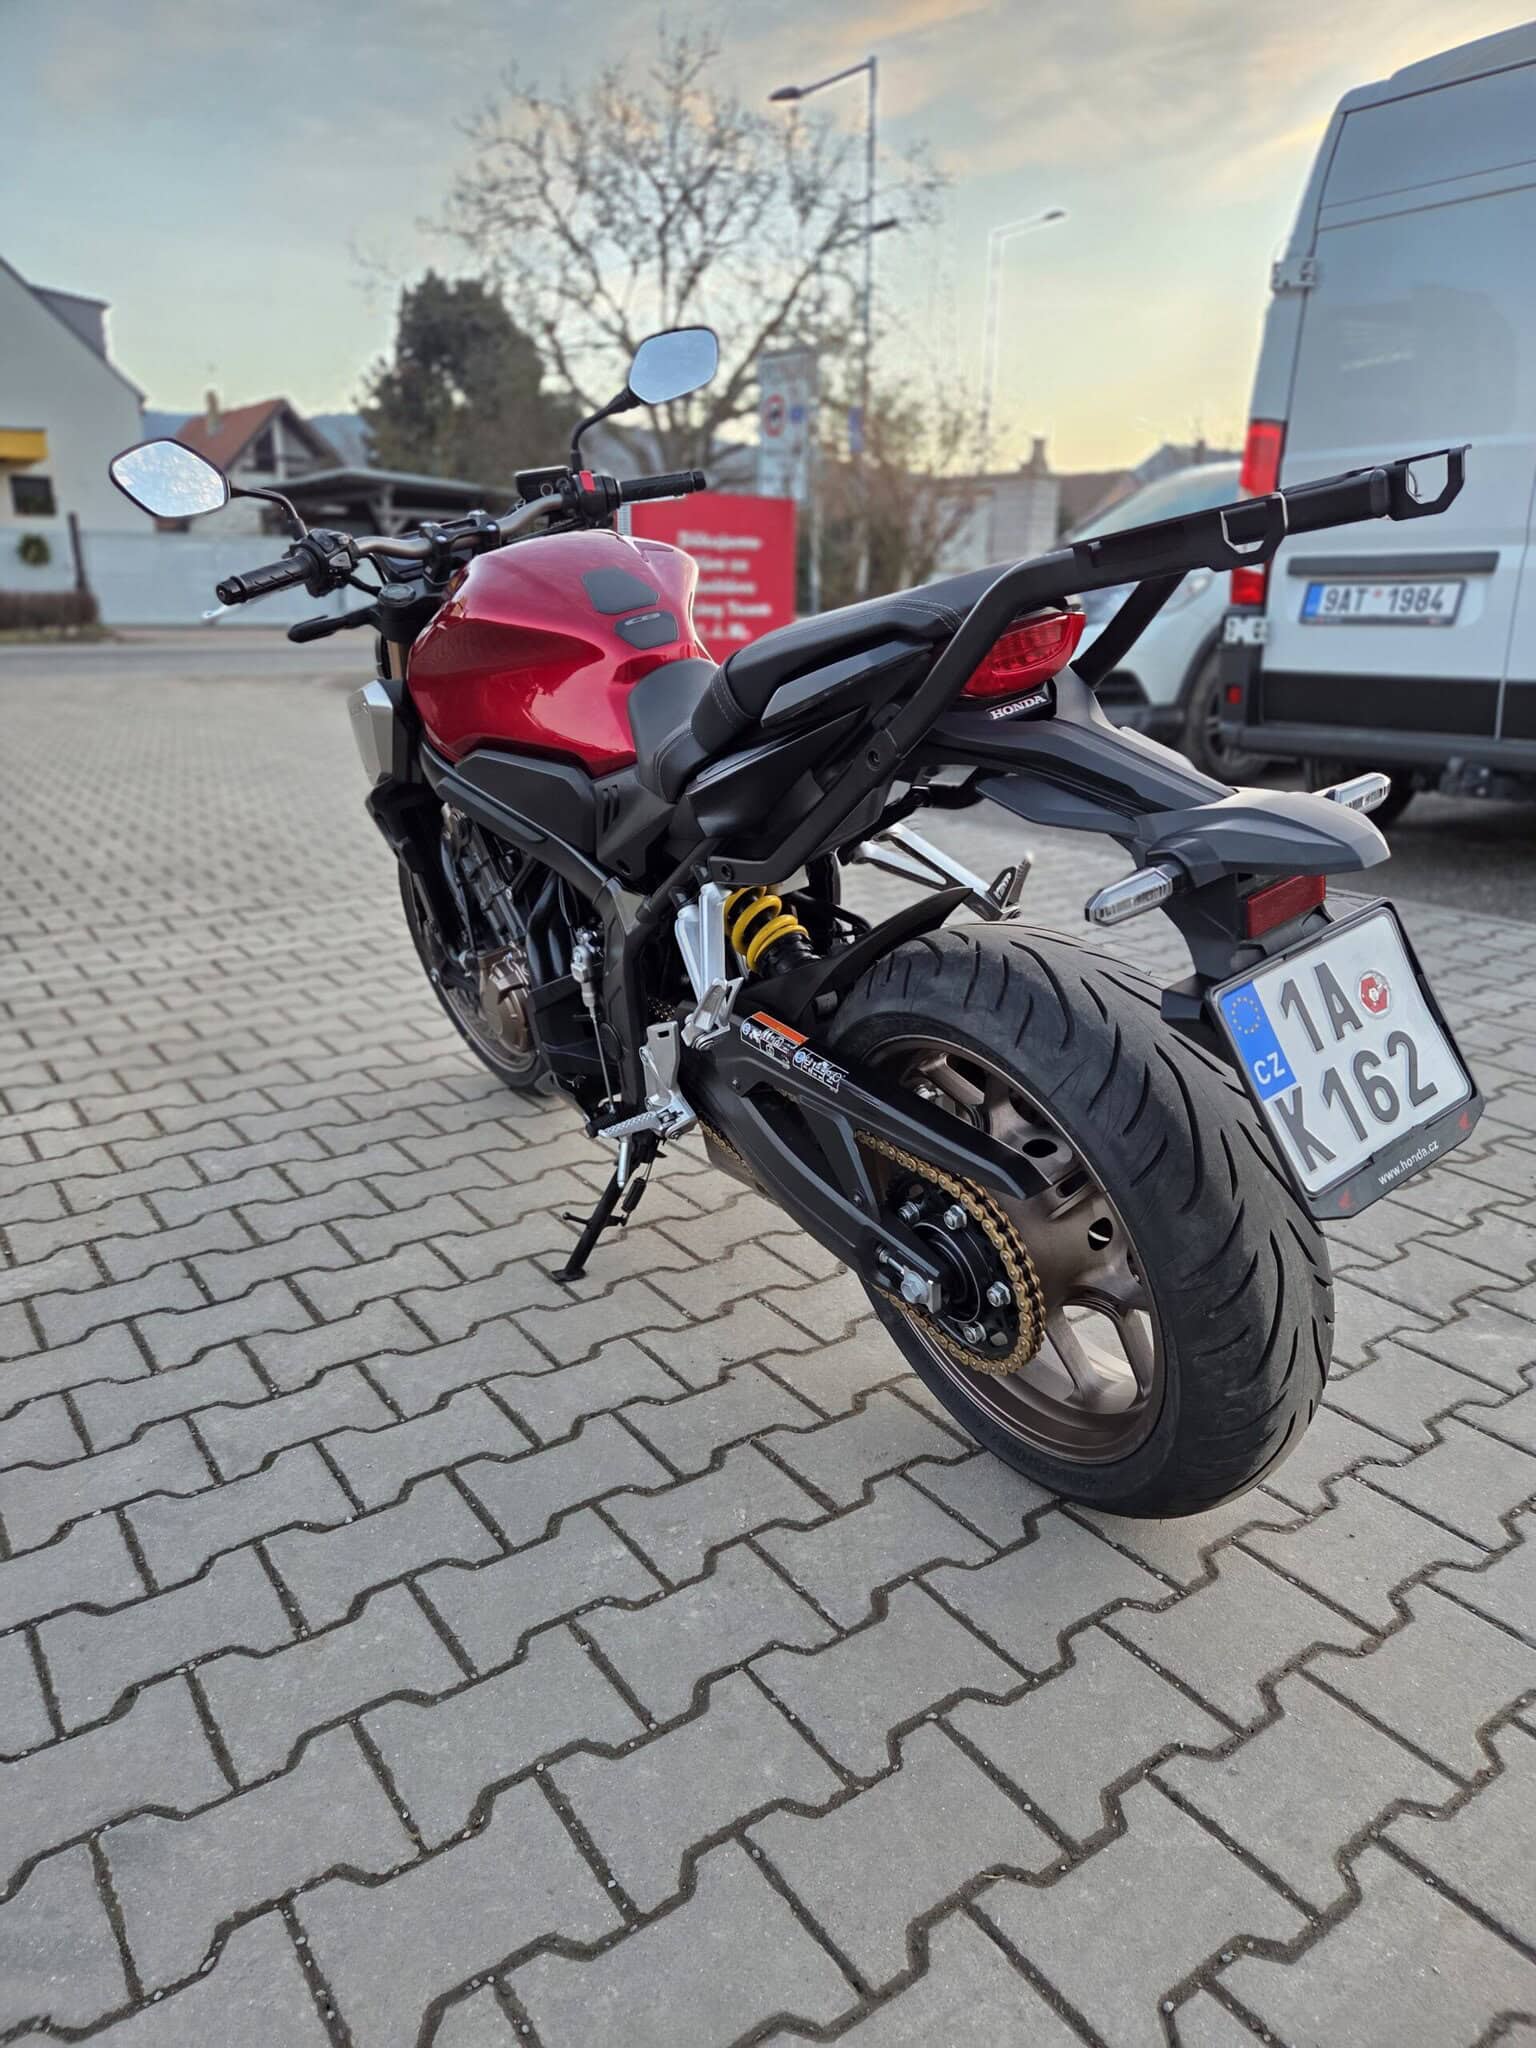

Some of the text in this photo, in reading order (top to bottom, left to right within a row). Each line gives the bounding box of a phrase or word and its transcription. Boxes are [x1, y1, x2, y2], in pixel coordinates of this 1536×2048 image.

[1324, 586, 1444, 614] 9AT 1984
[990, 695, 1047, 720] HONDA
[1279, 962, 1363, 1052] 1A
[1254, 1052, 1286, 1085] CZ
[1378, 1140, 1439, 1185] www.honda.cz
